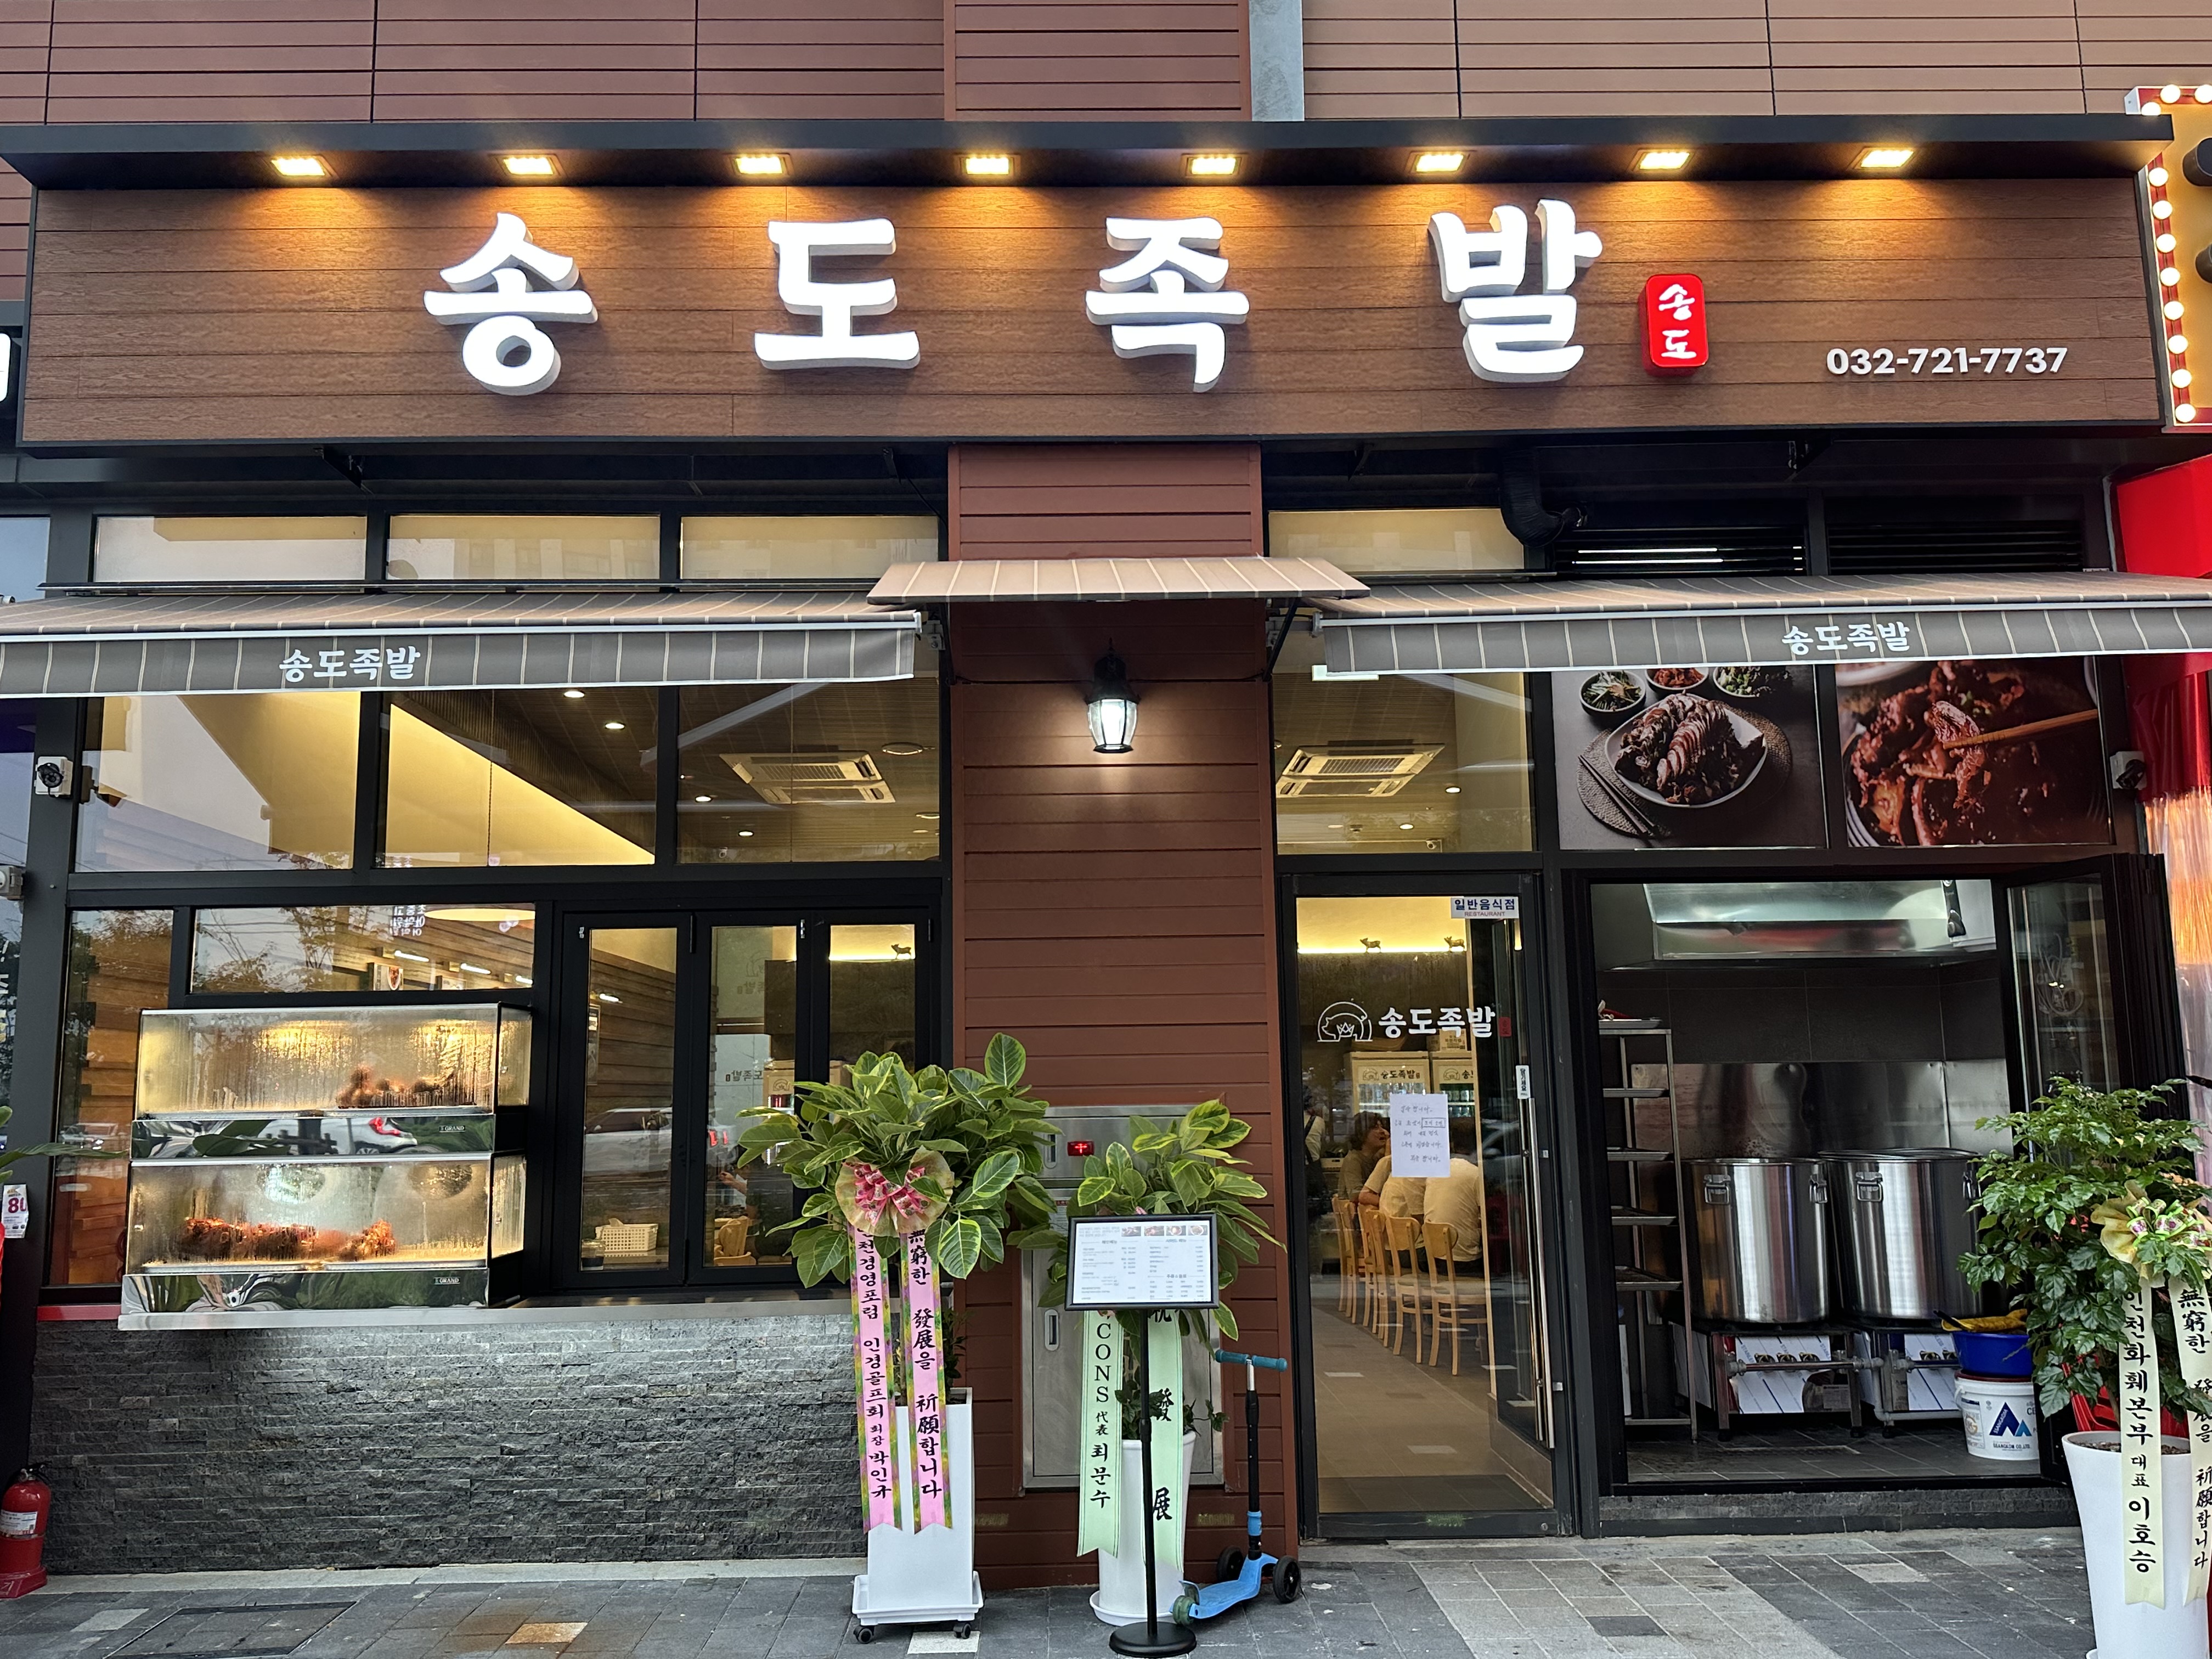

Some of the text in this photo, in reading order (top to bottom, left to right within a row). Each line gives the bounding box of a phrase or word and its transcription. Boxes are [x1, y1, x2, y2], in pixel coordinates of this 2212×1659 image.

[424, 199, 1602, 396] 송도족발
[1658, 284, 1697, 359] 송도
[1826, 347, 2068, 374] 032-721-7737
[279, 646, 421, 682] 송도족발
[1782, 622, 1910, 655] 송도족발
[1454, 899, 1515, 910] 일반음식점
[1378, 1006, 1496, 1039] 송도족발
[1380, 1069, 1415, 1079] 송도족발
[912, 1308, 936, 1370] 發展을
[2177, 1289, 2211, 1354] 無窮한
[864, 1338, 887, 1419] 인경골프회
[1094, 1315, 1112, 1403] CONS
[870, 1424, 885, 1446] 회장
[916, 1393, 943, 1499] 祈願합니다
[1095, 1410, 1109, 1436] 代表
[2123, 1291, 2156, 1573] 인천화훼본부 대표 이호승
[868, 1451, 892, 1499] 박인규
[1090, 1443, 1111, 1509] 최문수
